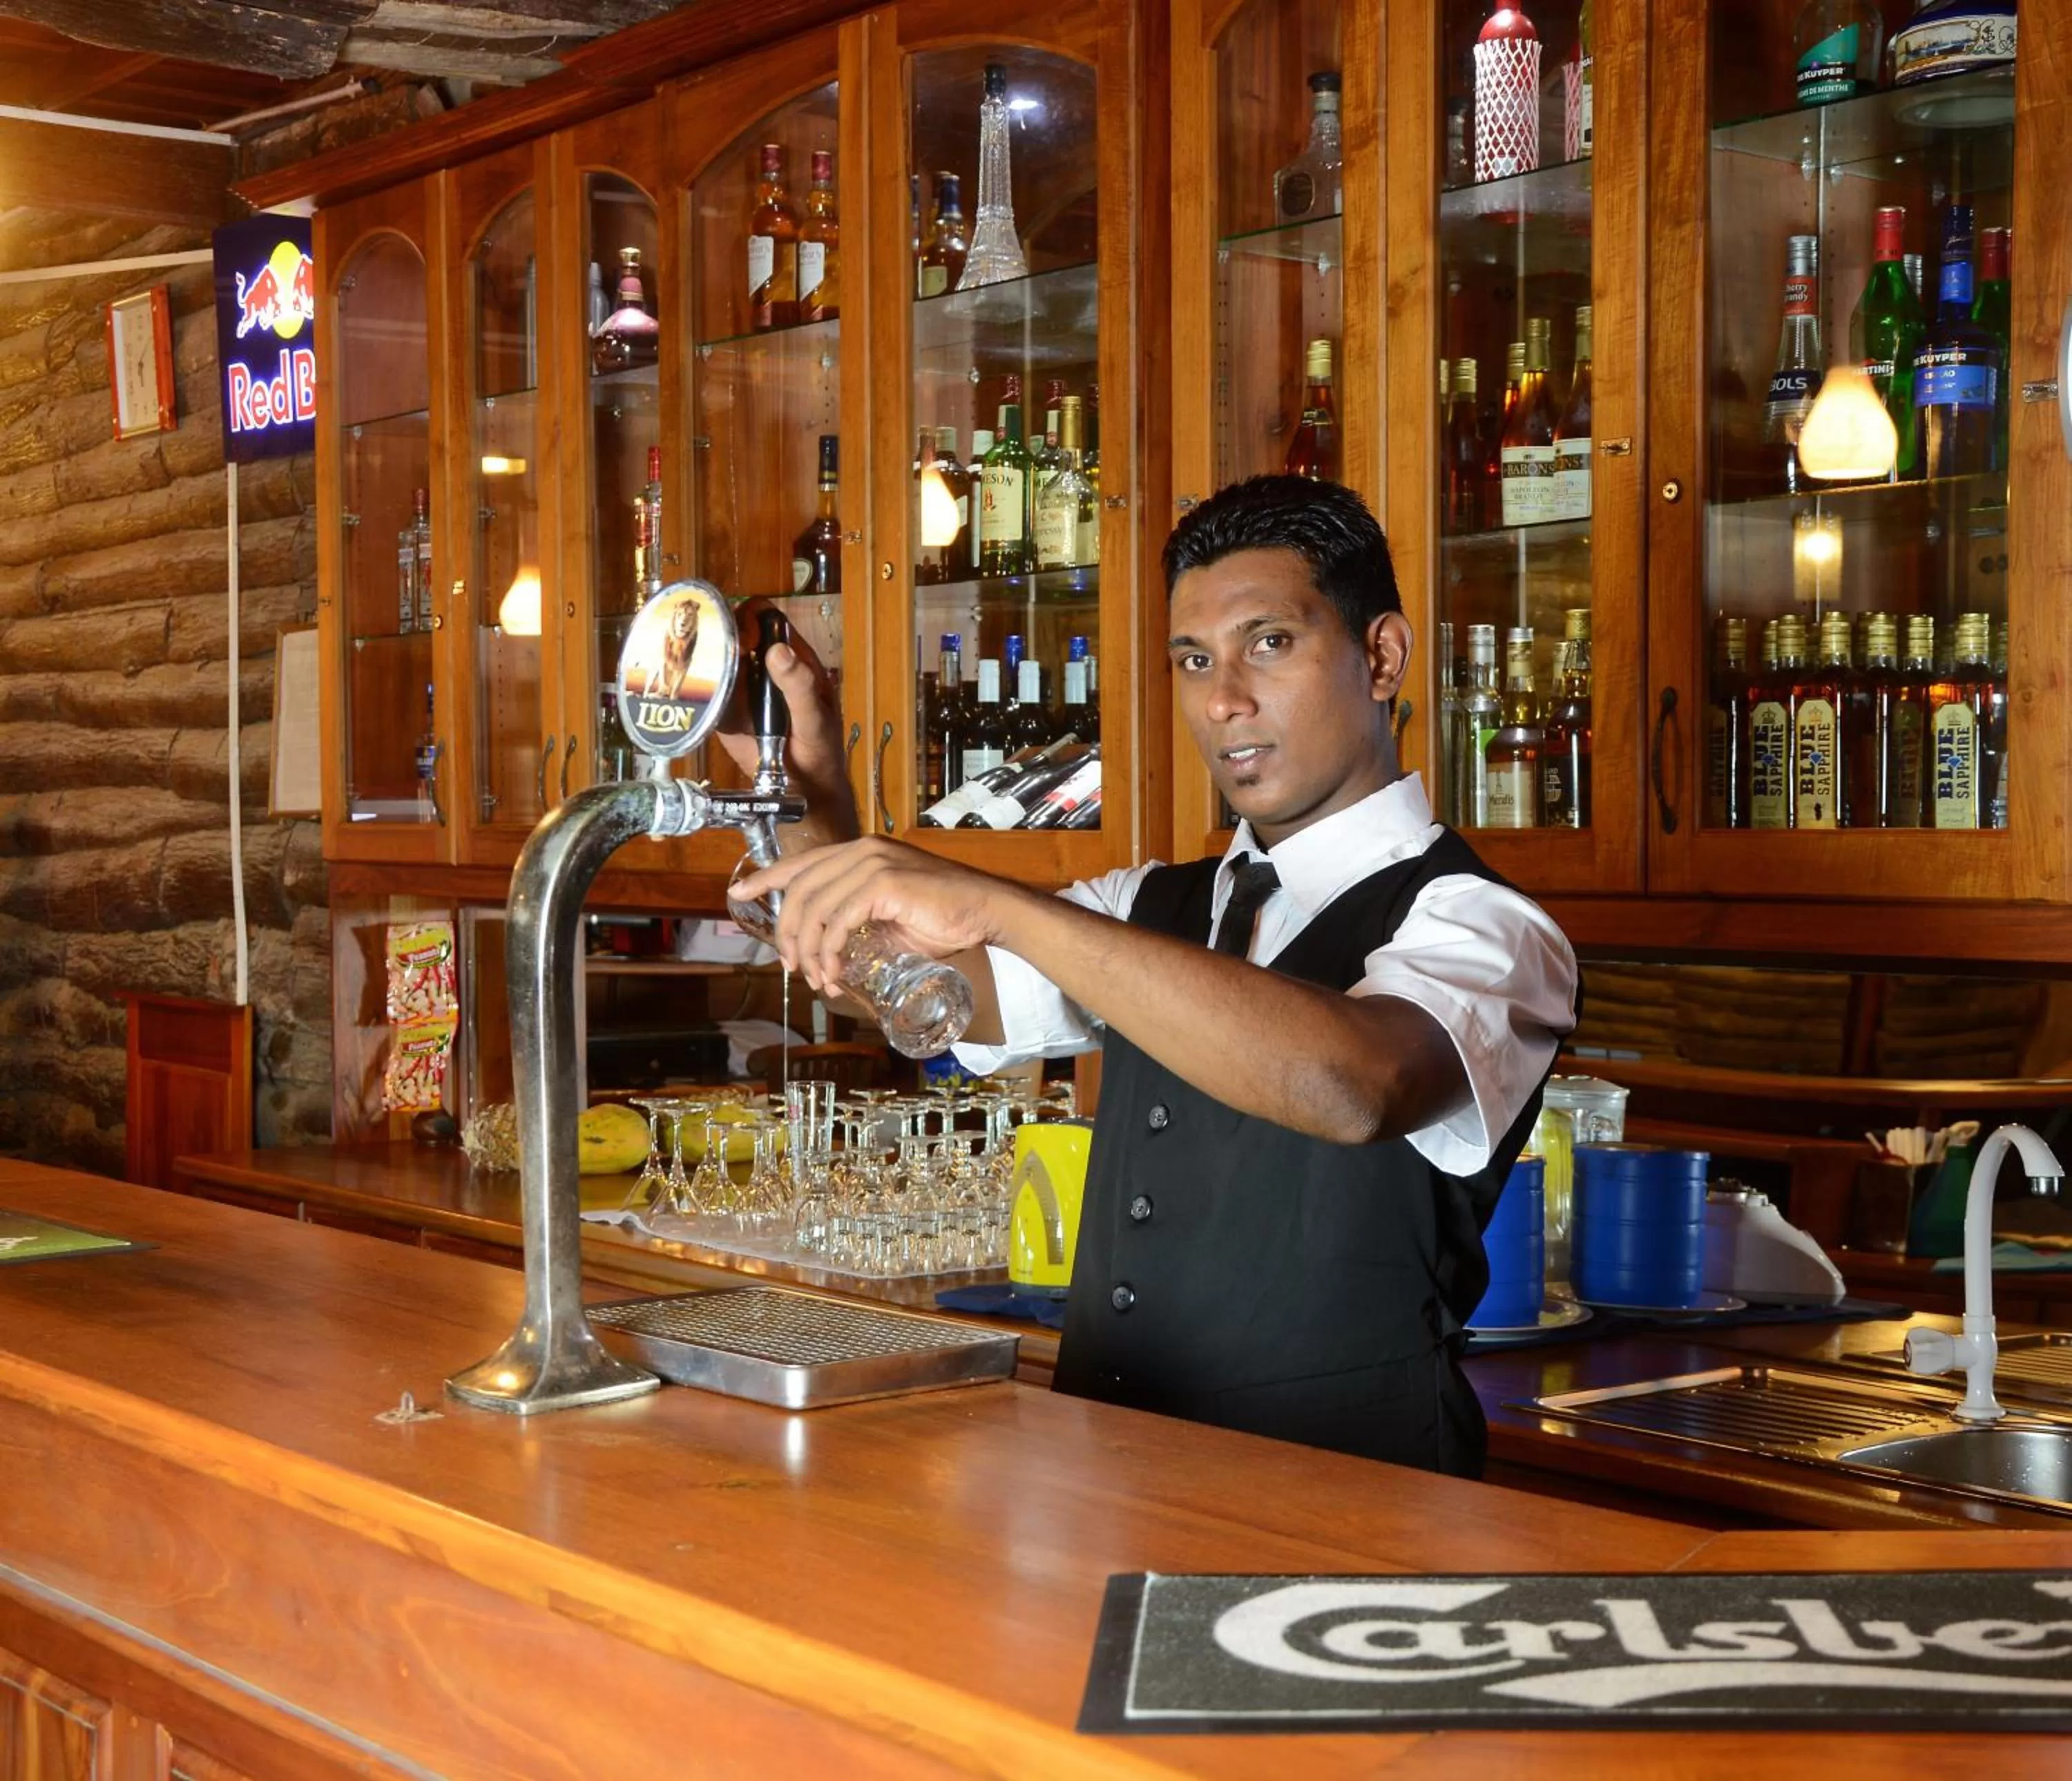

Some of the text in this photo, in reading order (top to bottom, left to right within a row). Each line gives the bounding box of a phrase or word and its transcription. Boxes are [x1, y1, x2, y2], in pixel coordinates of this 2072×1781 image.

[1804, 67, 1843, 79] KUYPER
[229, 349, 316, 432] Red B
[1920, 352, 1967, 365] KUYPER
[1507, 463, 1554, 475] BARONS
[636, 702, 695, 731] LION
[1754, 725, 1769, 797] BLUE
[1769, 723, 1785, 797] SAPPHIRE
[1800, 724, 1815, 796] BLUE
[1817, 723, 1831, 796] SAPPHIRE
[1937, 727, 1954, 799] BLUE
[1956, 726, 1970, 799] SAPPHIRE
[1213, 1581, 2072, 1683] Carlsbe
